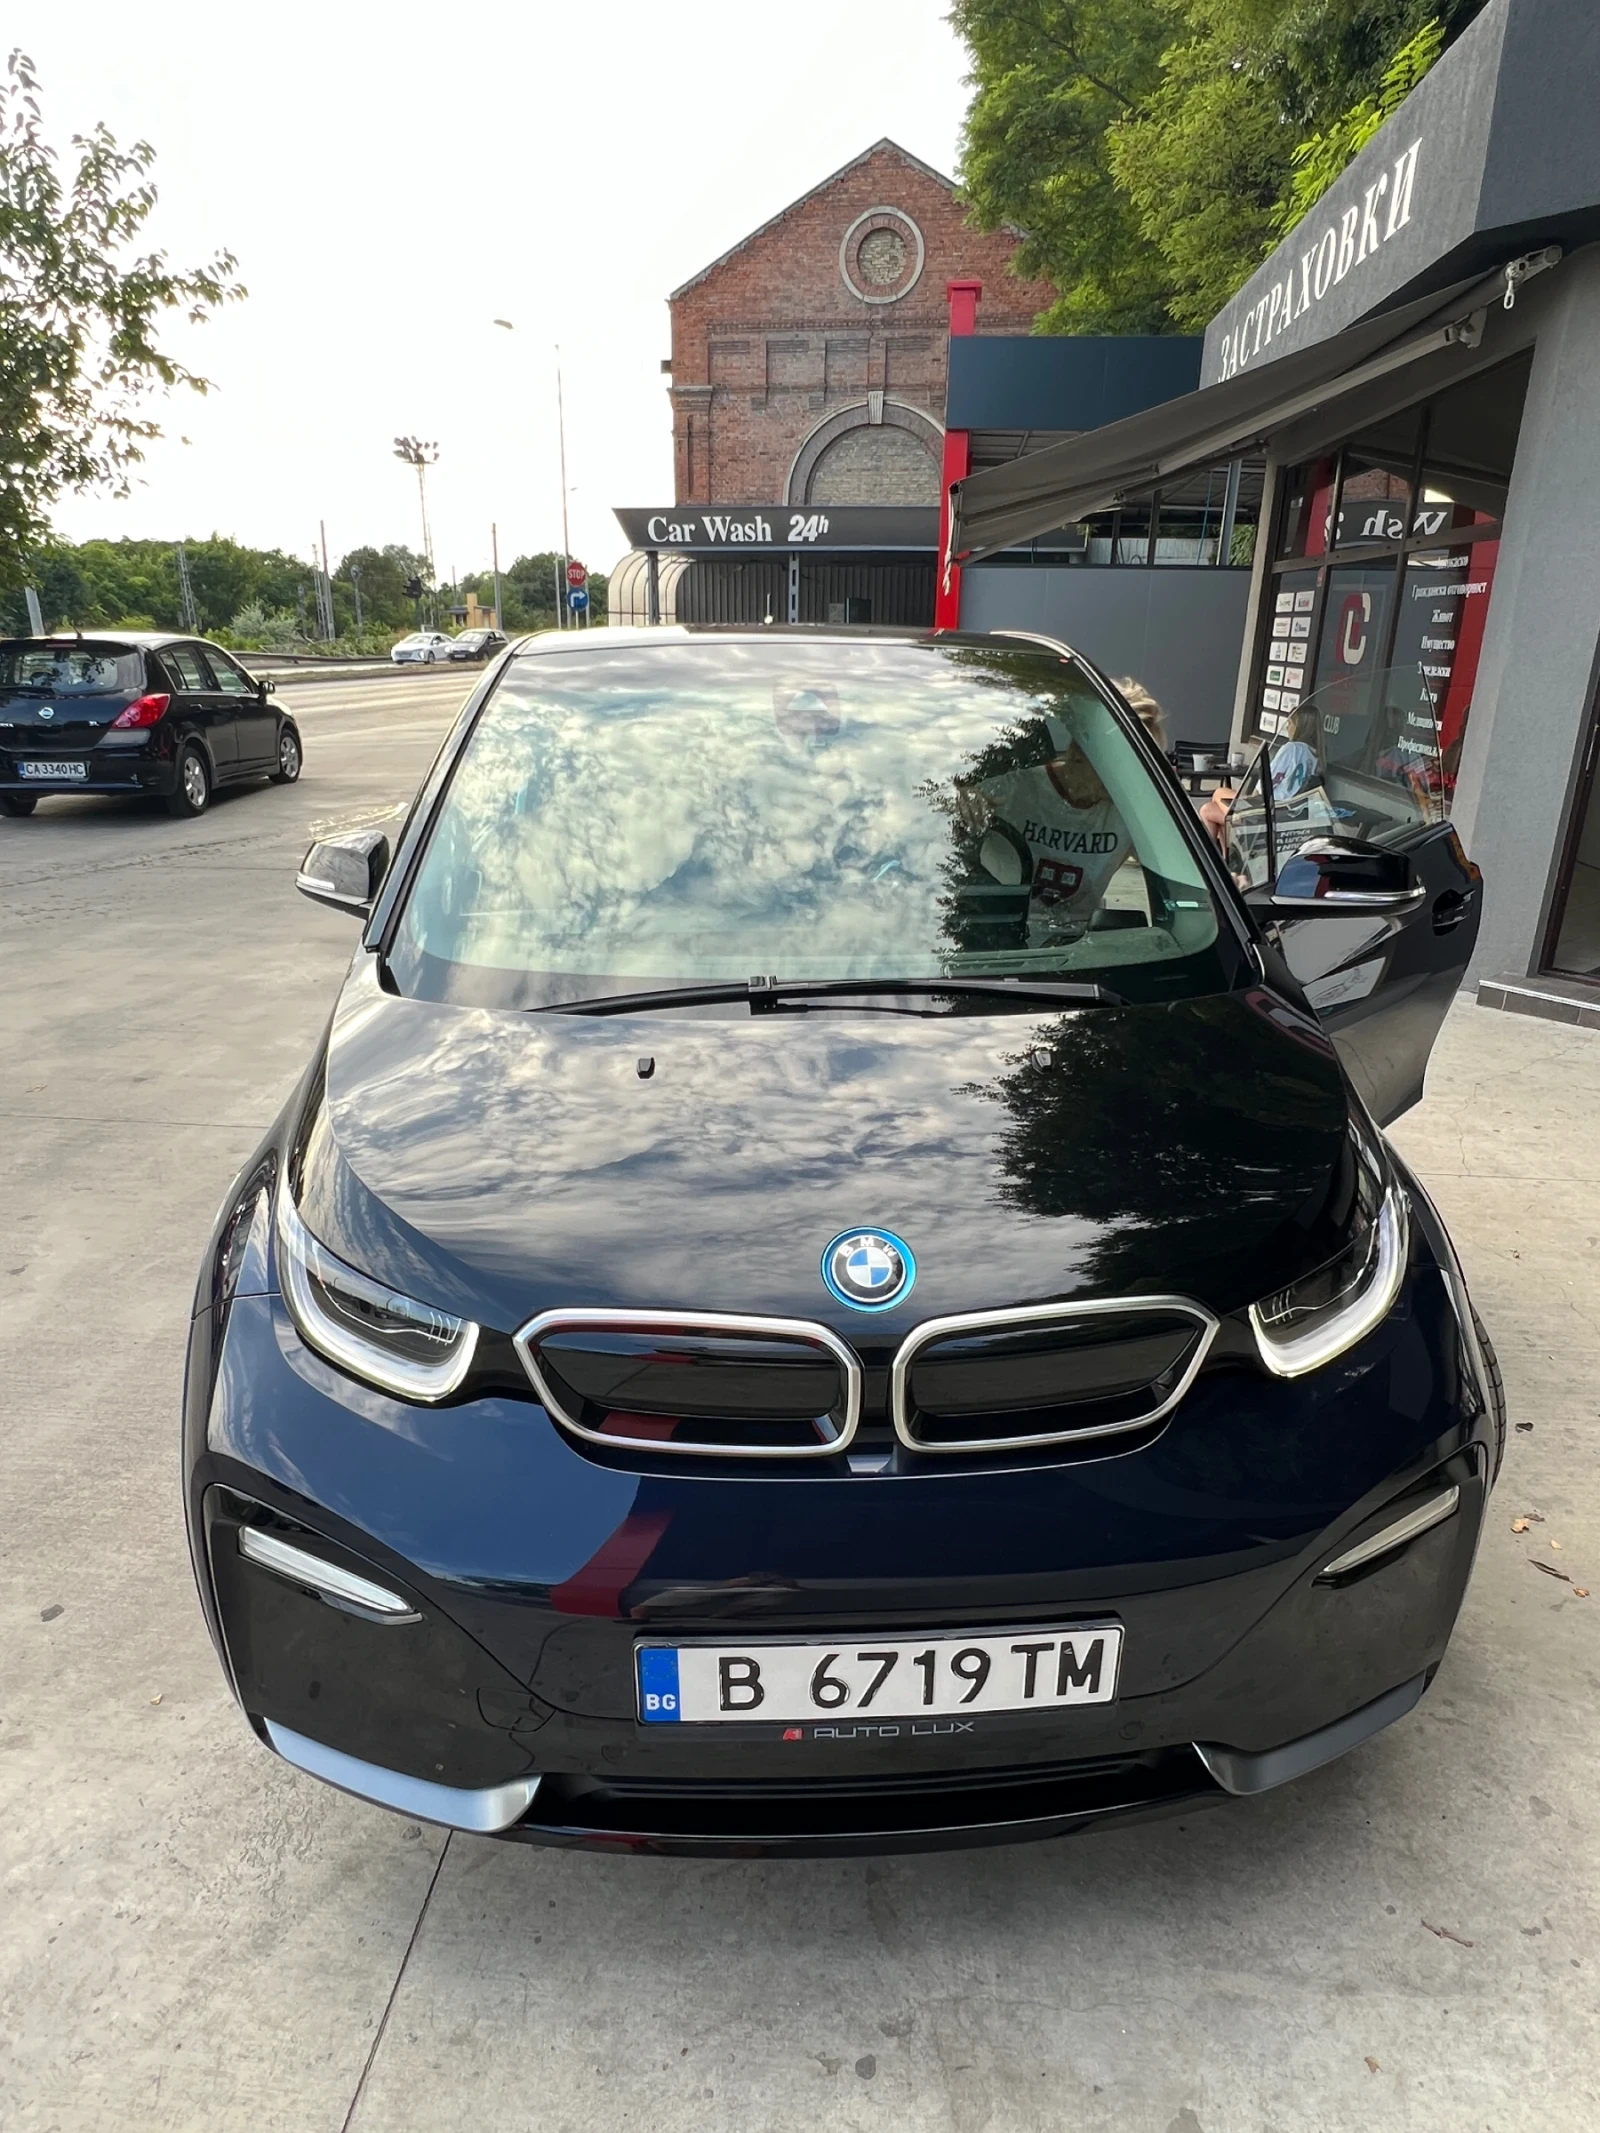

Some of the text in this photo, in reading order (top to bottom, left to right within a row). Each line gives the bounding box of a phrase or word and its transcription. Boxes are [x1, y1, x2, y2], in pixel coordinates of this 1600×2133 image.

[1218, 137, 1423, 383] ЗАСТРАХОВКИ
[647, 514, 829, 542] Car Wash 24h
[567, 569, 585, 579] STOP
[26, 764, 83, 774] CA 3340 HC
[1023, 819, 1118, 853] HARVARD
[839, 1236, 897, 1257] BMW
[646, 1639, 1104, 1710] BG B 6719 TM
[813, 1726, 899, 1738] AUTO
[911, 1721, 975, 1735] LUX
